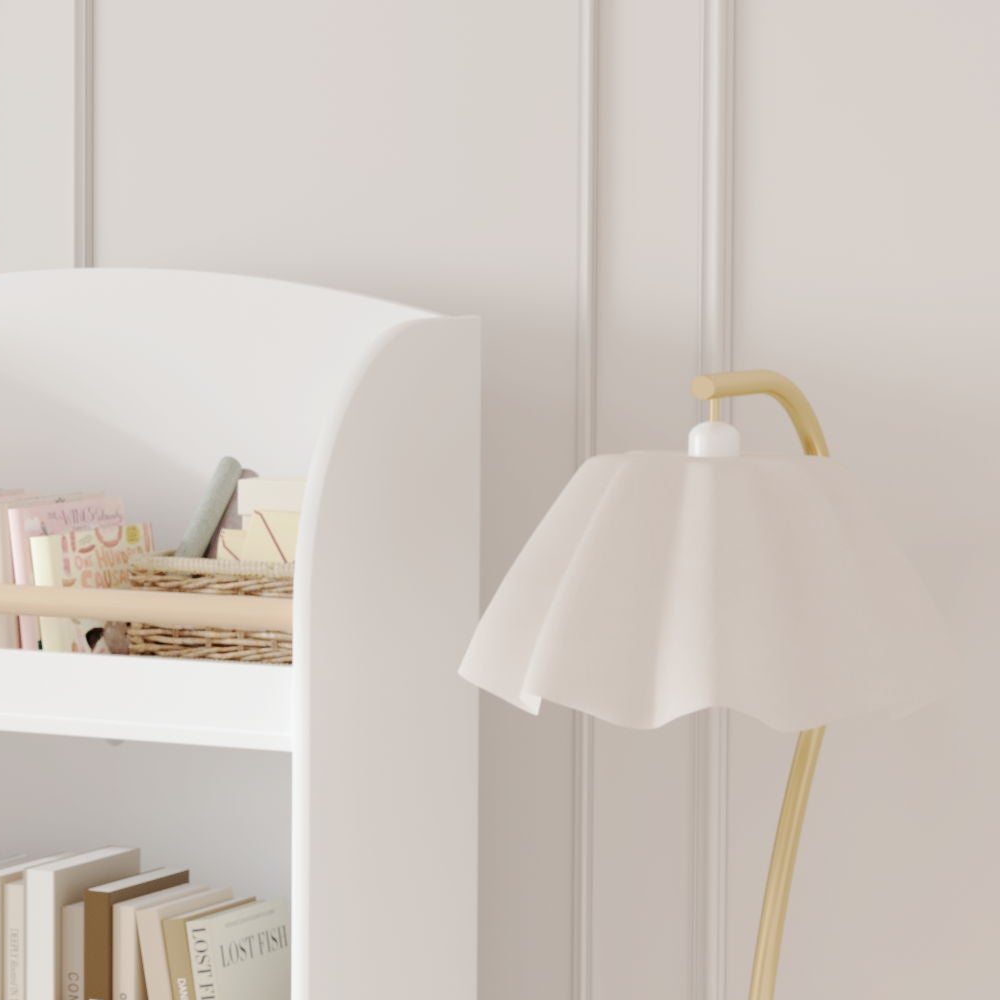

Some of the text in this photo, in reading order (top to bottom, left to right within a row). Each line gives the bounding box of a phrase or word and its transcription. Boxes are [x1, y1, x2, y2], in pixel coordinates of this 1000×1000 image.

[191, 927, 212, 977] LOST
[220, 924, 288, 968] LOST FISH
